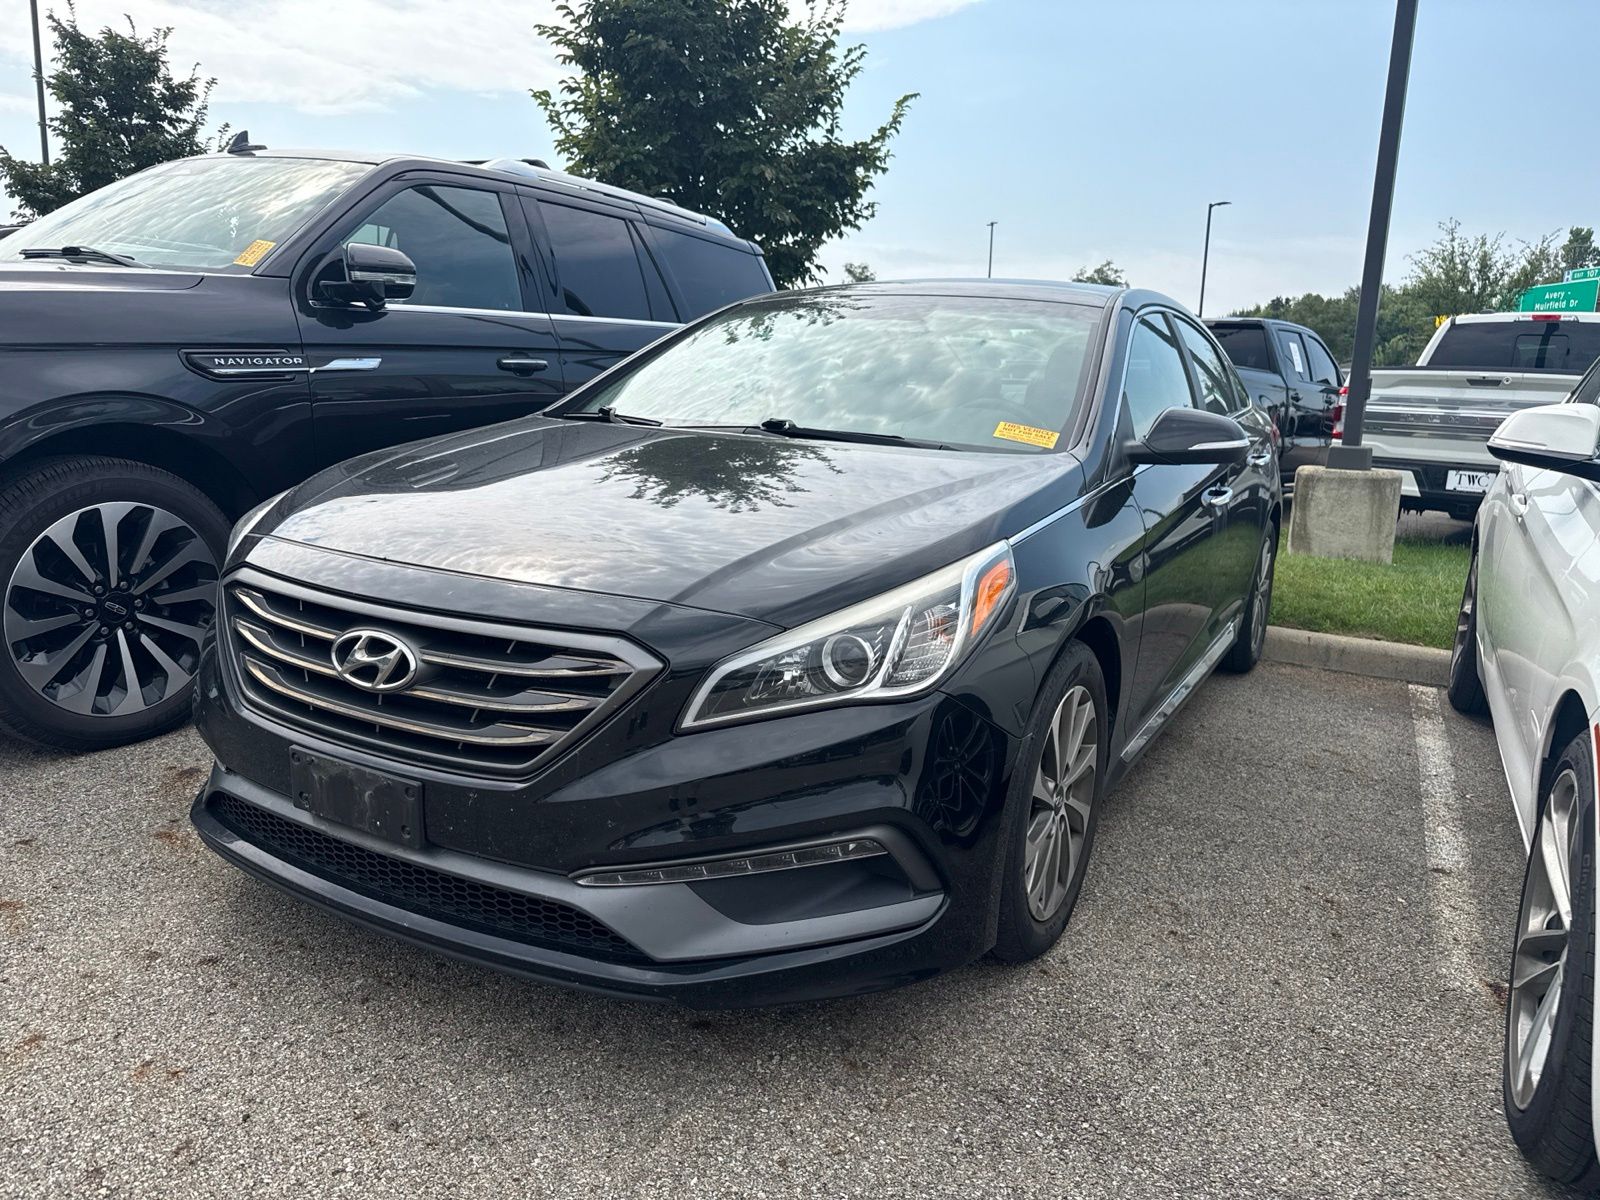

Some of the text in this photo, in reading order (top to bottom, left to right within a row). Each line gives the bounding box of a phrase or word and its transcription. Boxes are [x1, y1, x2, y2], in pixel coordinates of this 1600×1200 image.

[1587, 269, 1598, 277] 107
[1544, 291, 1565, 300] Avery
[1535, 299, 1578, 310] Muirfield Dr
[214, 357, 303, 366] NAVIGATOR
[1023, 426, 1056, 436] VEHICLE
[1456, 474, 1490, 488] TWC
